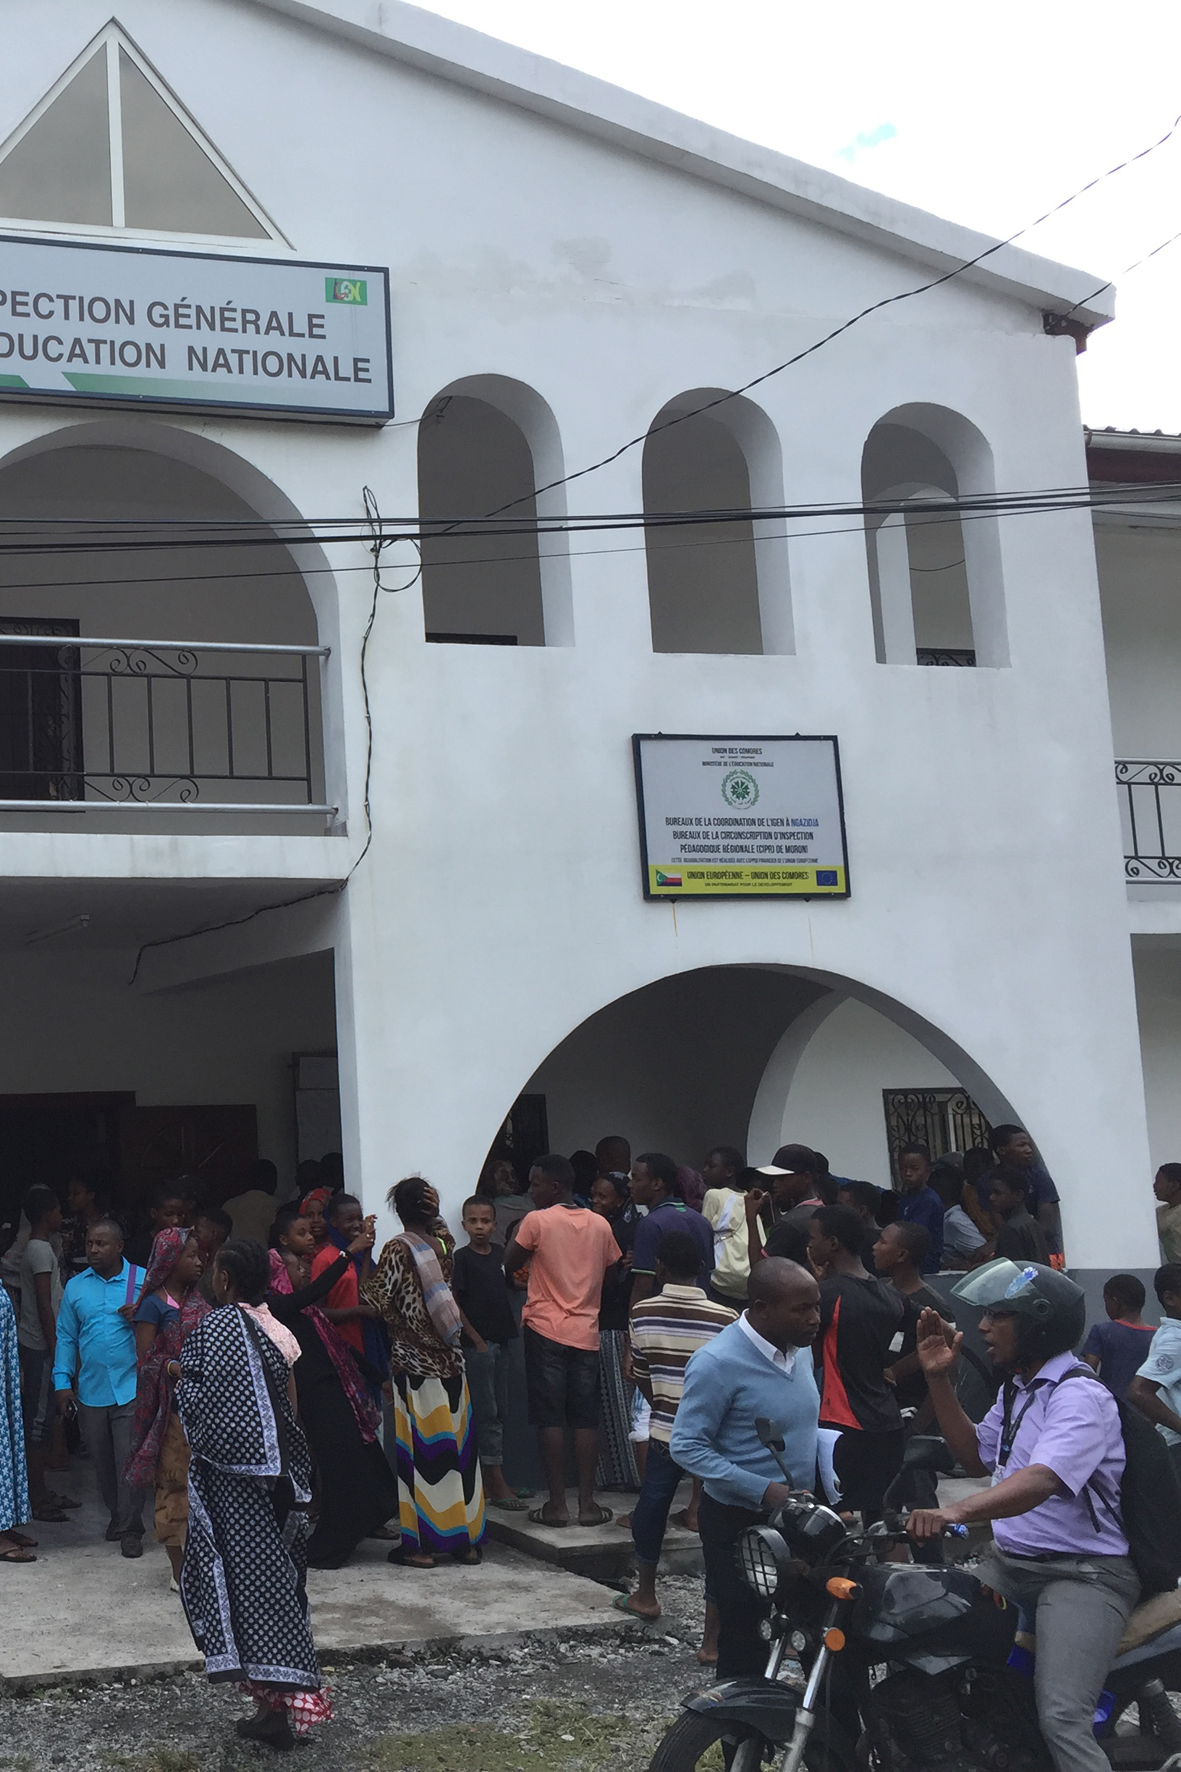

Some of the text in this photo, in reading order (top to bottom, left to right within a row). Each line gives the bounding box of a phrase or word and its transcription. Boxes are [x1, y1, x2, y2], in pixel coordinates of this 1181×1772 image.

[146, 296, 327, 340] GÉNÉRALE
[187, 345, 372, 384] NATIONALE
[711, 747, 763, 755] UNION DES COMORES
[665, 816, 694, 827] BUREAUX
[695, 816, 703, 827] DE
[704, 817, 712, 827] LA
[712, 817, 757, 827] COORDINATION
[757, 817, 765, 827] DE
[785, 815, 791, 827] À
[791, 818, 819, 828] NGAZIDJA
[672, 830, 814, 841] BUREAUX DE LA CIRCONSCRIPTION D'INSPECTION
[680, 842, 722, 854] PÉDAGOGIQUE
[723, 842, 755, 854] RÉGIONALE
[776, 844, 784, 854] DE
[785, 844, 809, 854] MORONI
[687, 871, 705, 880] UNION
[706, 869, 744, 880] EUROPÉENNE
[750, 871, 769, 880] UNION
[770, 871, 781, 880] DES
[782, 871, 810, 880] COMORES
